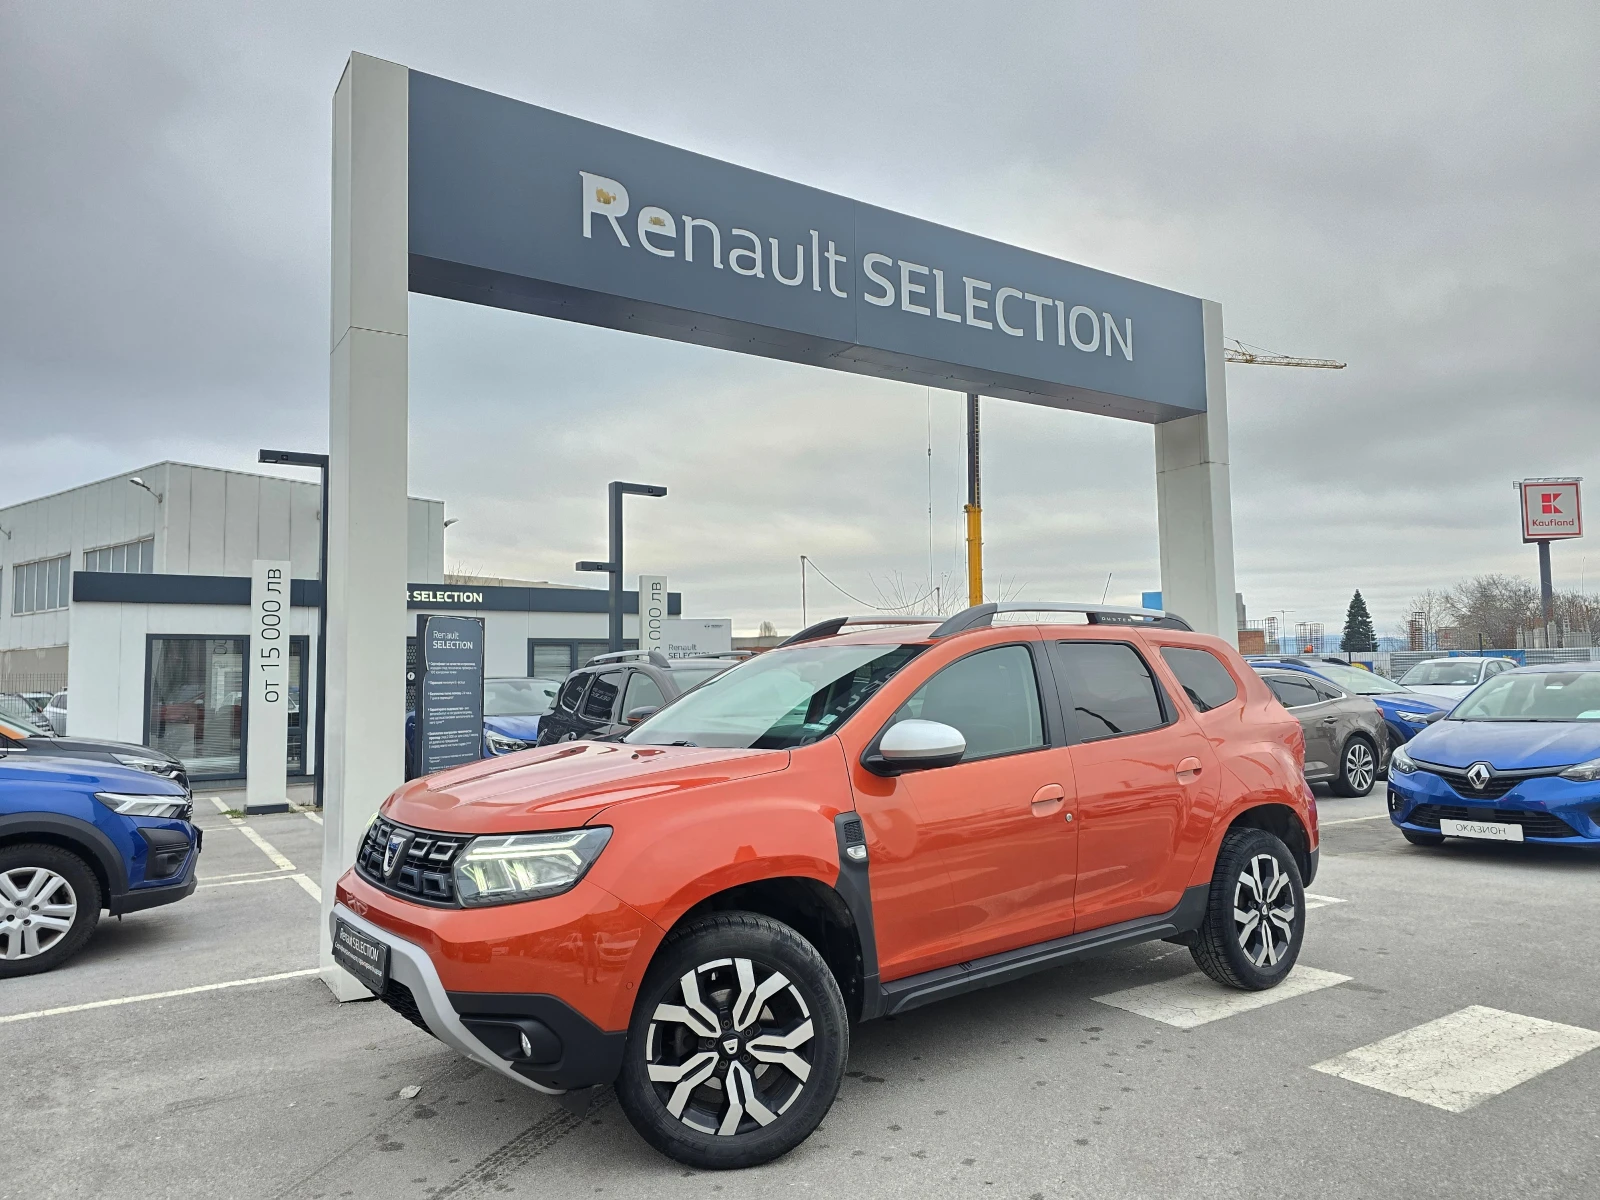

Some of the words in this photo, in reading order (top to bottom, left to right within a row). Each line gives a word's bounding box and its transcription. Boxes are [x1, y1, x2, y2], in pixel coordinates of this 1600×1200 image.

[579, 170, 847, 298] Renault
[863, 252, 1133, 361] SELECTION
[1532, 518, 1574, 527] Kaufland
[413, 591, 483, 603] SELECTION
[261, 600, 281, 640] 000
[433, 631, 459, 639] Renault
[433, 641, 473, 649] SELECTION
[261, 648, 280, 672] 15
[1455, 823, 1506, 835] ОКАЗИОН
[352, 938, 379, 962] SELECTION
